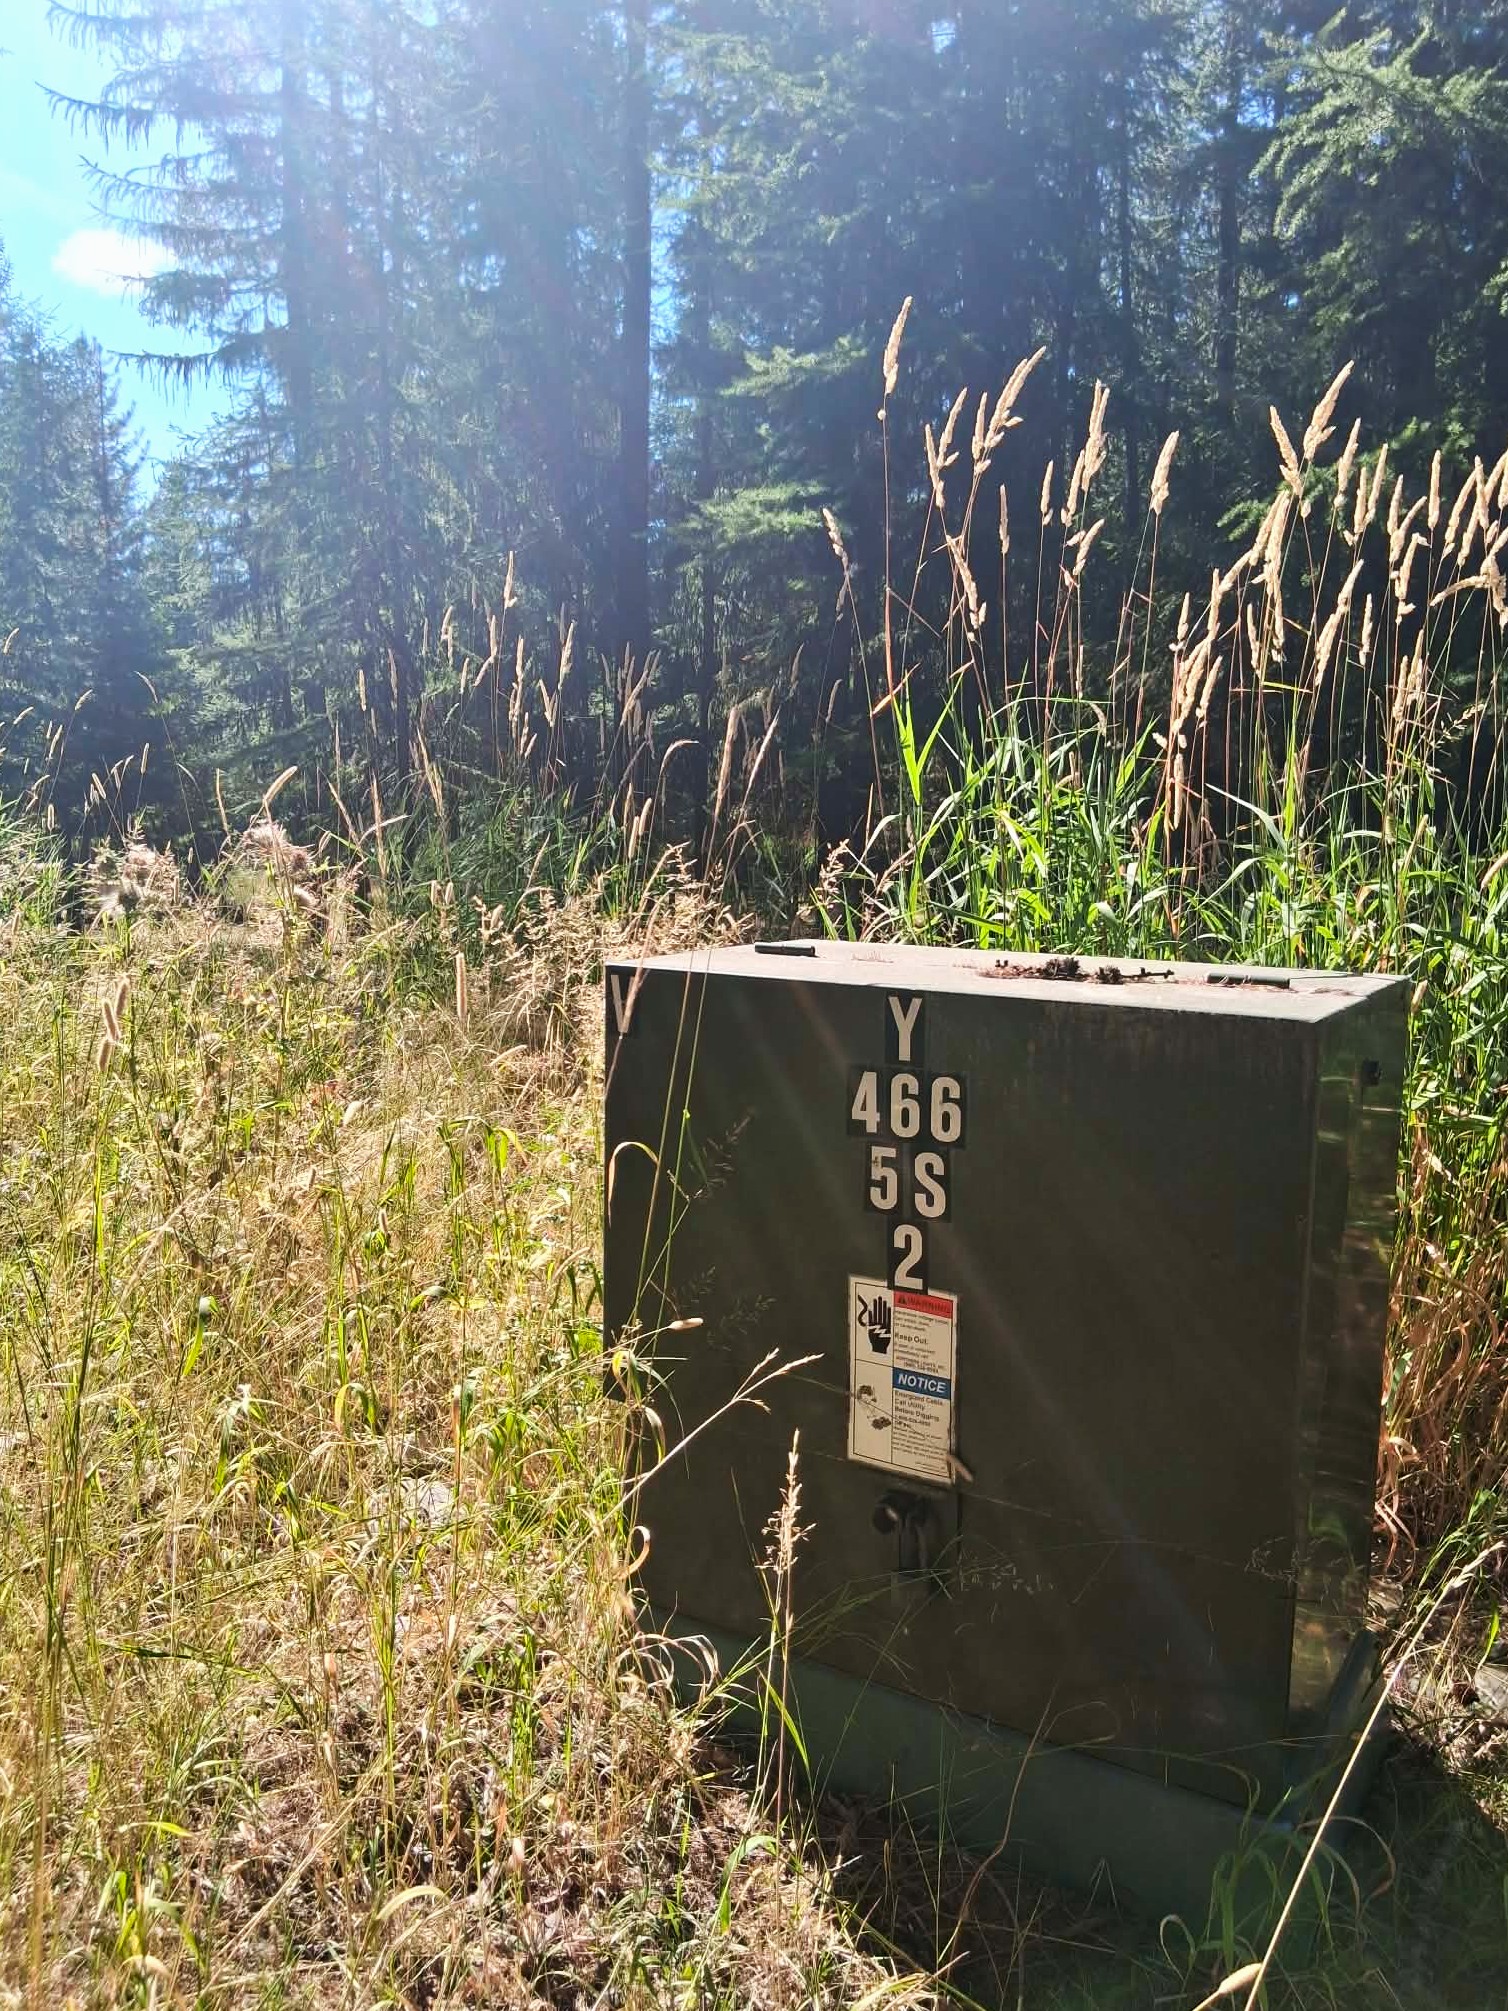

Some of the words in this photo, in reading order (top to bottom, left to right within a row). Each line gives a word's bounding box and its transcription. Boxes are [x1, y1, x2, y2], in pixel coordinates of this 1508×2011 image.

[888, 996, 923, 1061] Y
[851, 1071, 962, 1143] 466
[870, 1146, 947, 1218] 5S
[893, 1224, 923, 1290] 2
[898, 1374, 946, 1393] NOTICE
